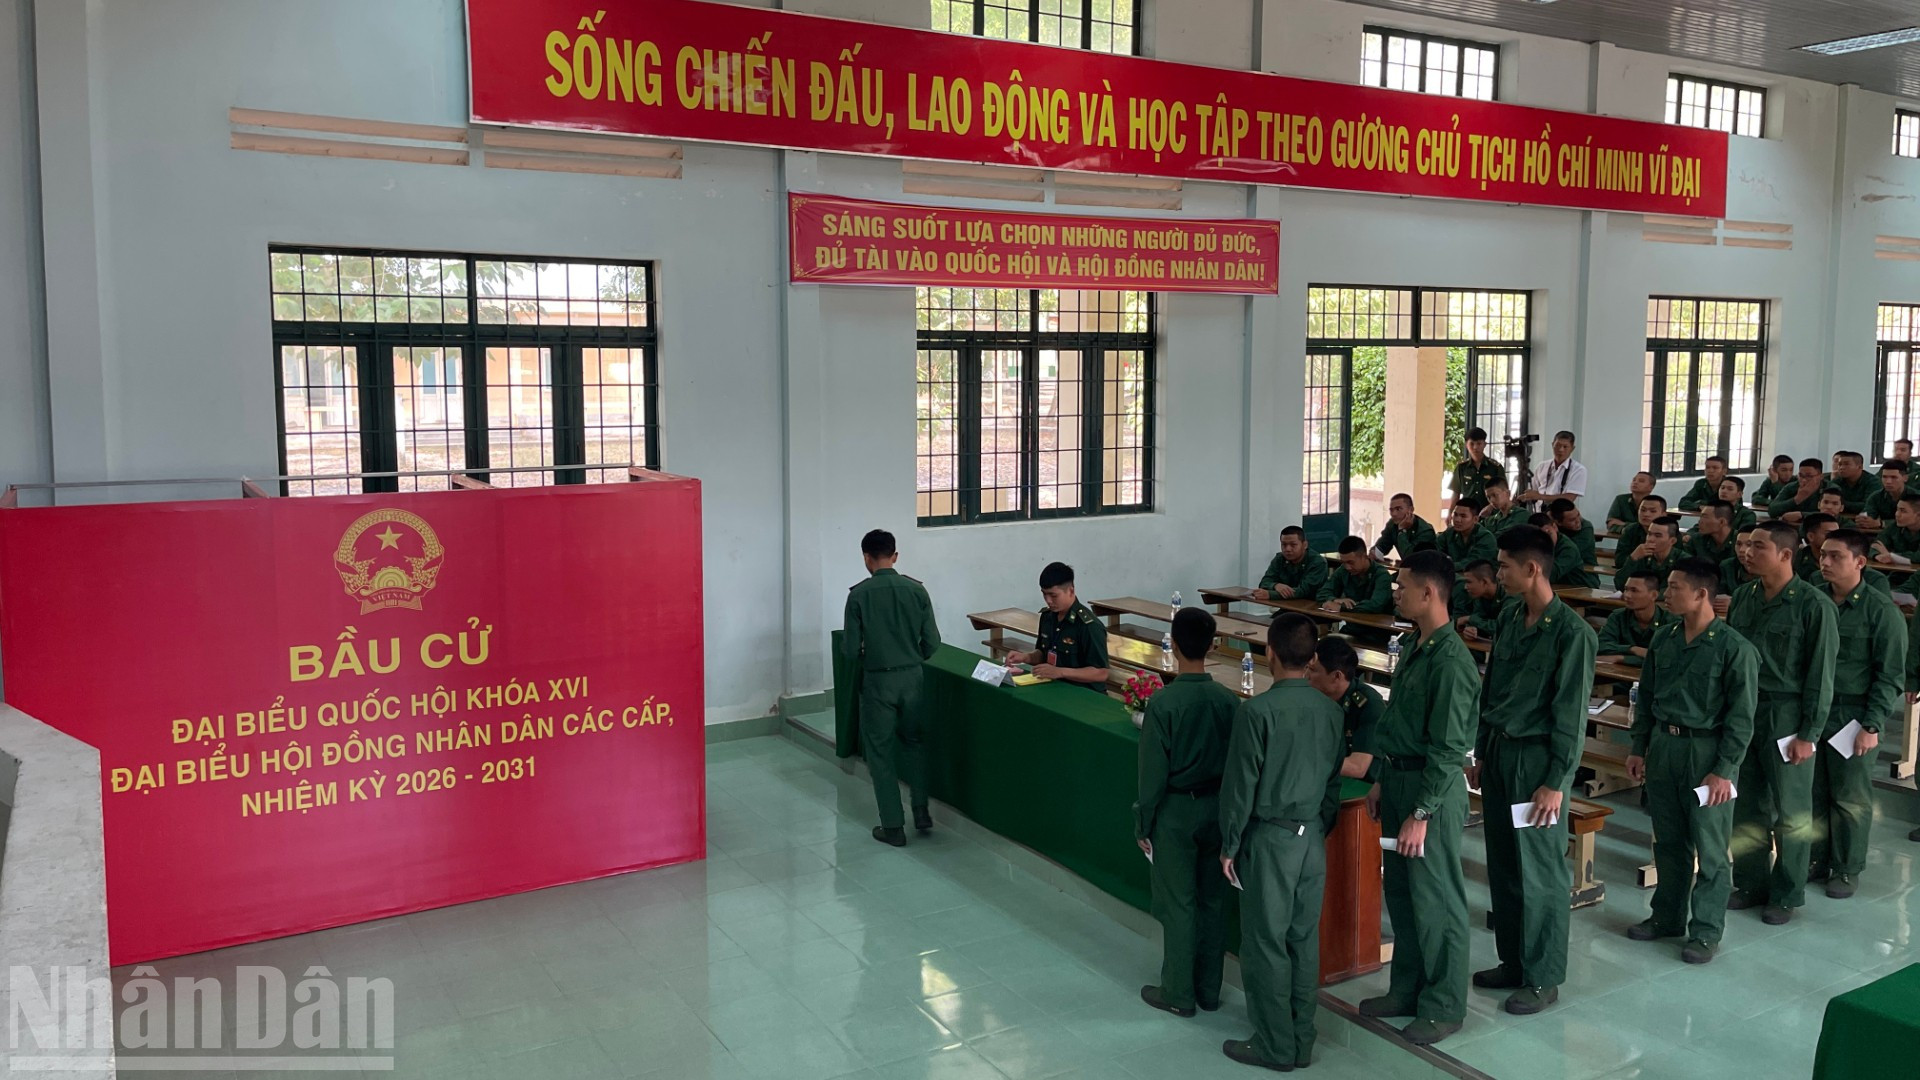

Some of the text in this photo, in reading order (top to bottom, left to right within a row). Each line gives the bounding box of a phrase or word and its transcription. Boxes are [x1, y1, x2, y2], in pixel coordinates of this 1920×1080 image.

[545, 10, 1701, 205] SỐNG CHIẾN ĐẤU, LAO ĐỘNG VÀ HỌC TẬP THEO GƯƠNG CHỦ TỊCH HỒ CHÍ MINH VĨ ĐẠI
[815, 240, 1264, 280] ĐỦ TÀI VÀO QUỐC HỘI VÀ HỘI ĐỒNG NHÂN DÂN!
[823, 211, 1262, 256] SÁNG SUỐT LỰA CHỌN NHỮNG NGƯỜI ĐỦ ĐỨC,
[290, 616, 493, 682] BẦU CỬ
[172, 676, 588, 746] ĐẠI BIỂU QUỐC HỘI KHÓA XVI
[111, 695, 673, 794] ĐẠI BIỂU HỘI ĐỒNG NHÂN DÂN CÁC CẤP,
[241, 774, 337, 817] NHIỆM
[348, 770, 386, 800] KỲ
[397, 766, 456, 795] 2026
[482, 756, 534, 783] 2031
